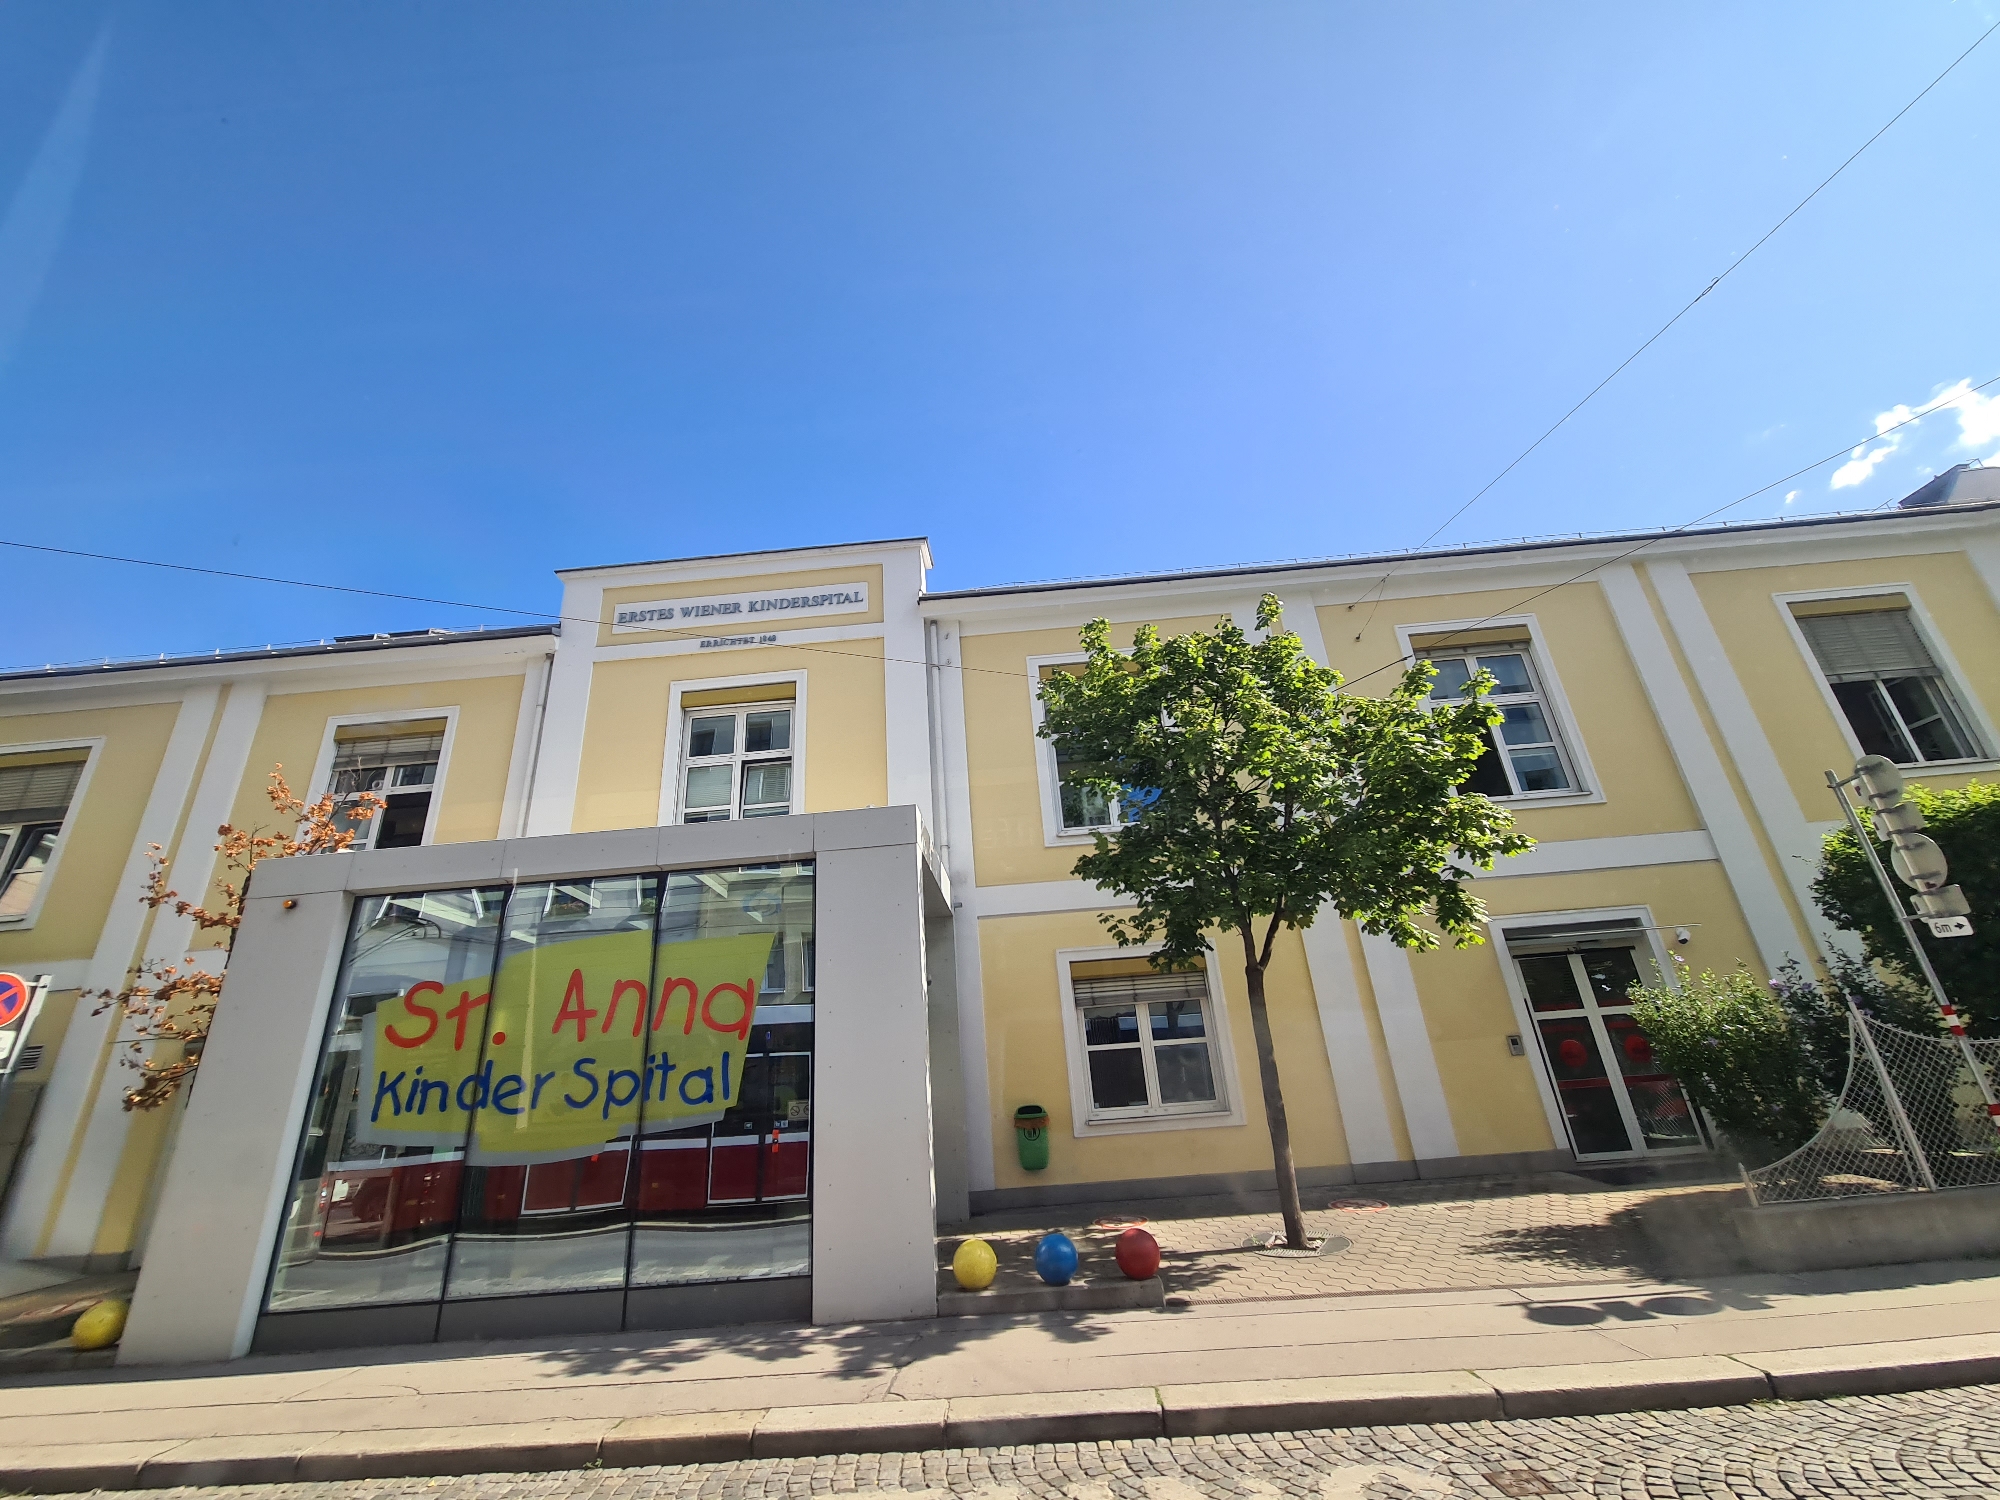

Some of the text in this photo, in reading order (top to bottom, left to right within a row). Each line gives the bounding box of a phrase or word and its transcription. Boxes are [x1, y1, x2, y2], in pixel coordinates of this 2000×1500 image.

[617, 591, 864, 624] ERSTES WIENER KINDERSPITAL
[1934, 922, 1953, 934] 6m
[384, 968, 755, 1051] St. Anna
